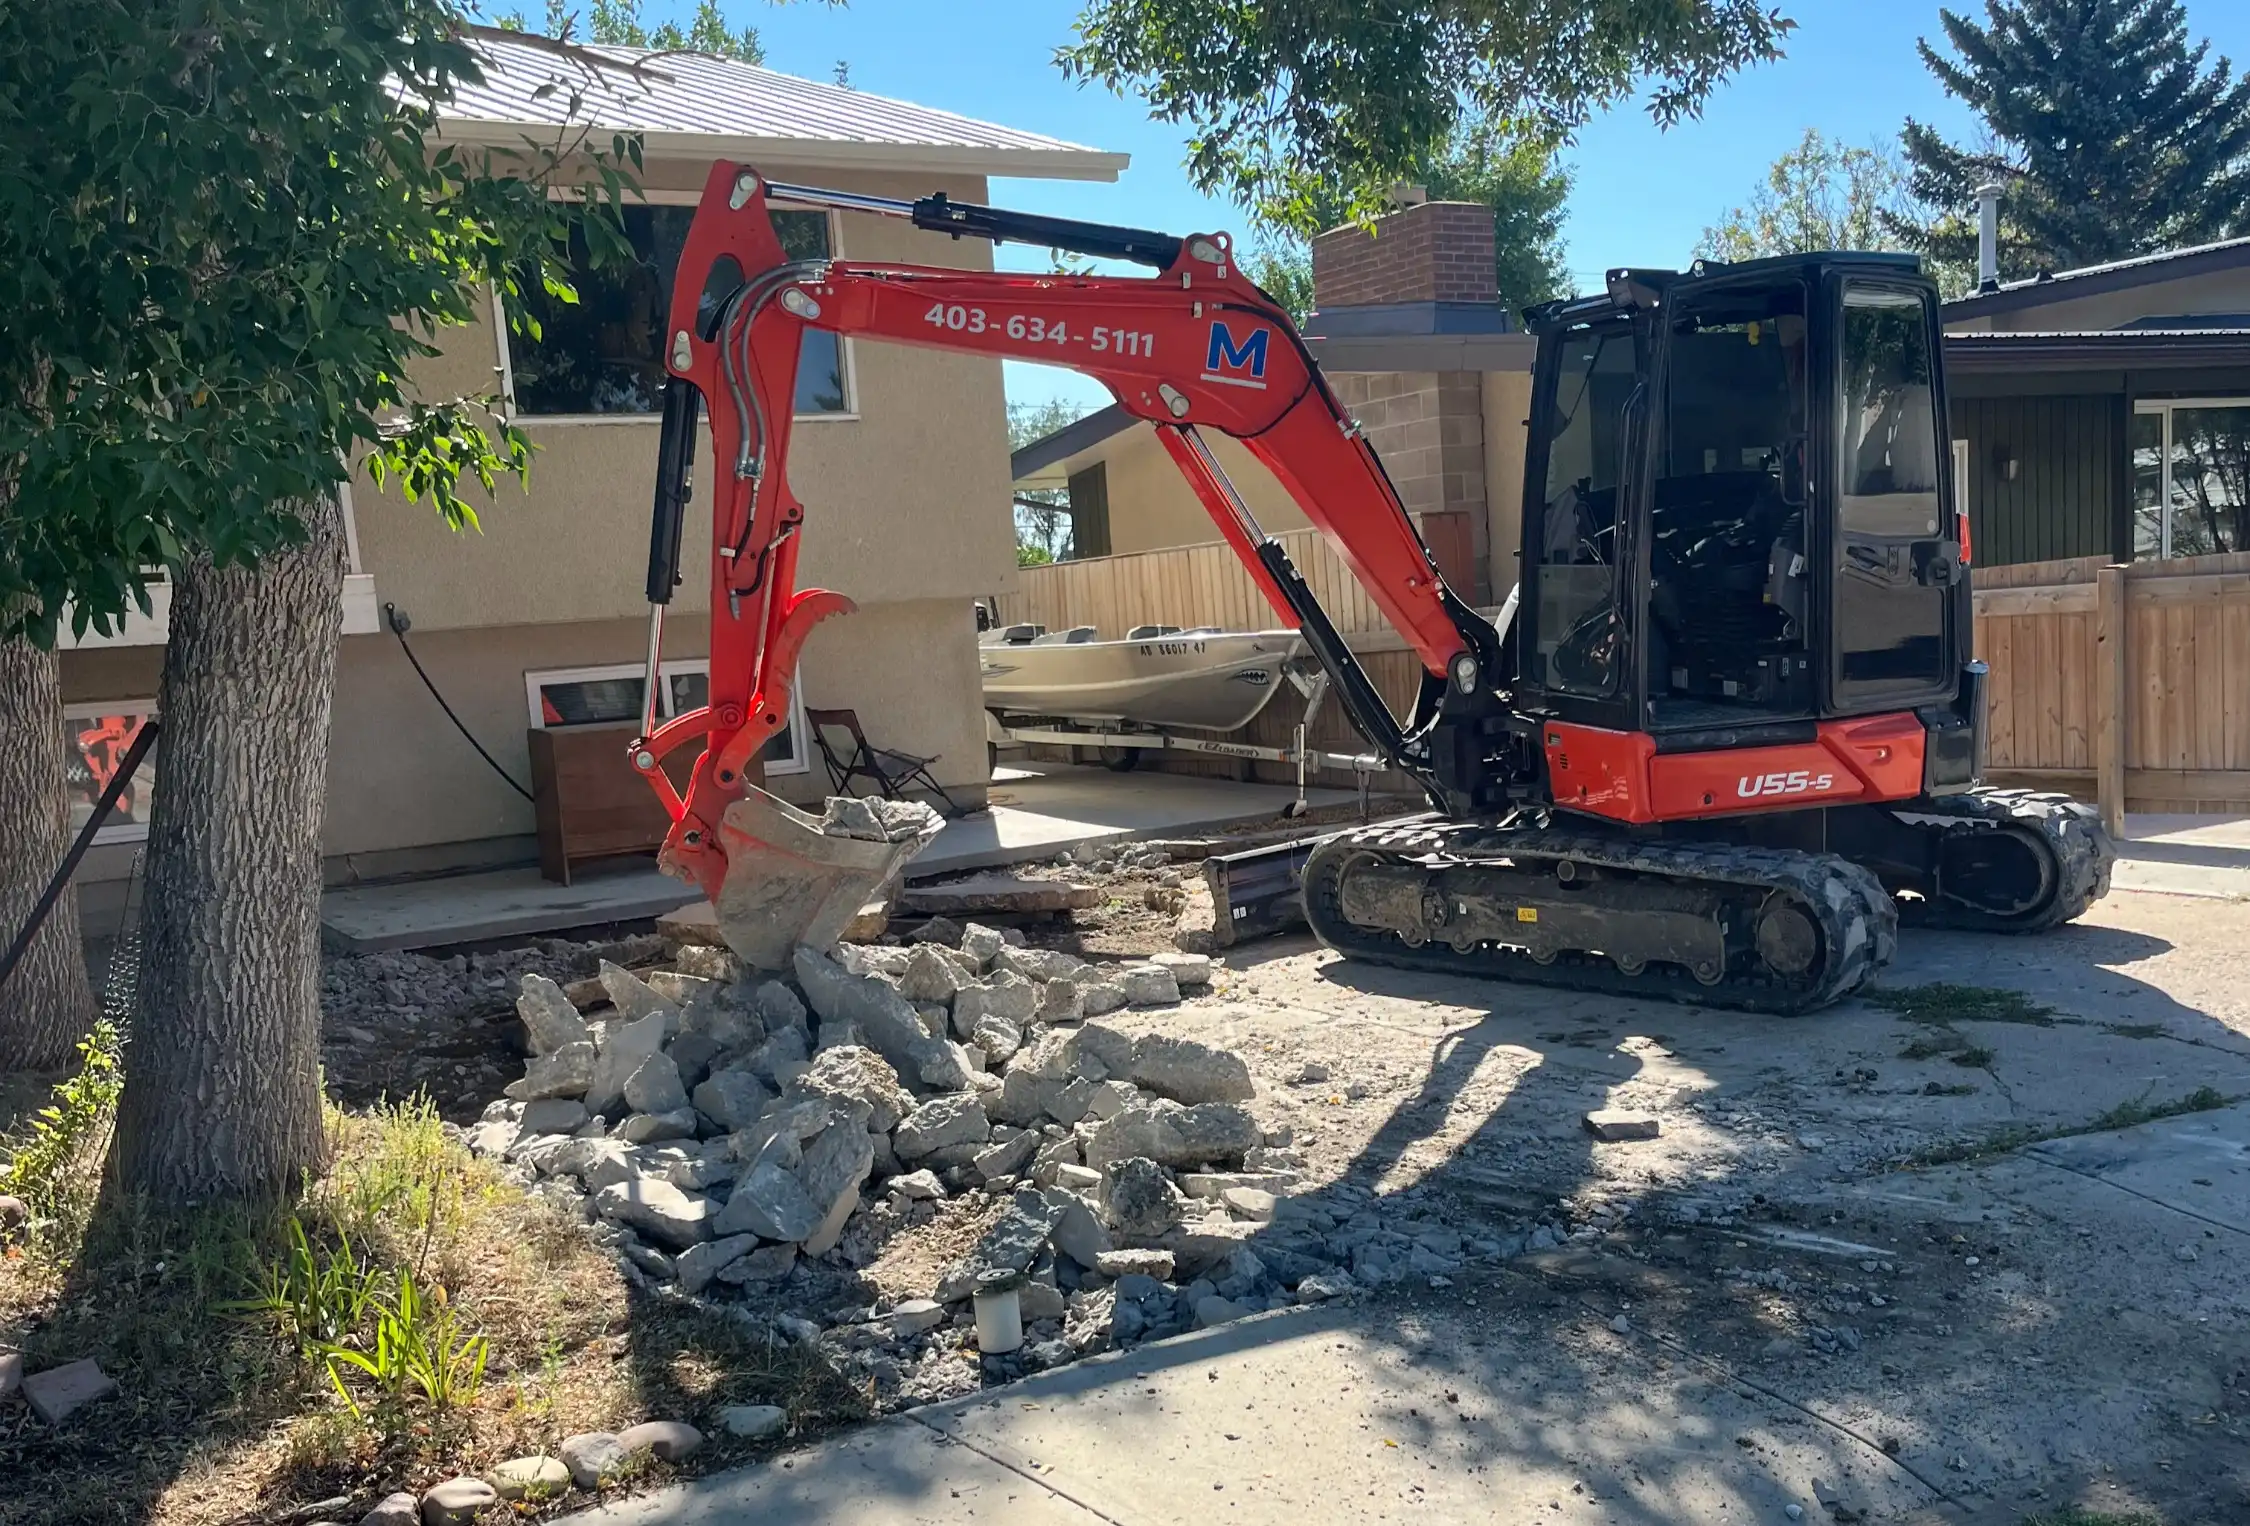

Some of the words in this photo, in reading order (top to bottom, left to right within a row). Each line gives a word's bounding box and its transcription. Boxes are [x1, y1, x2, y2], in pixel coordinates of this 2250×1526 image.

[924, 303, 1154, 357] 403-634-5111
[1206, 321, 1271, 378] M
[1737, 771, 1833, 798] U55-5
